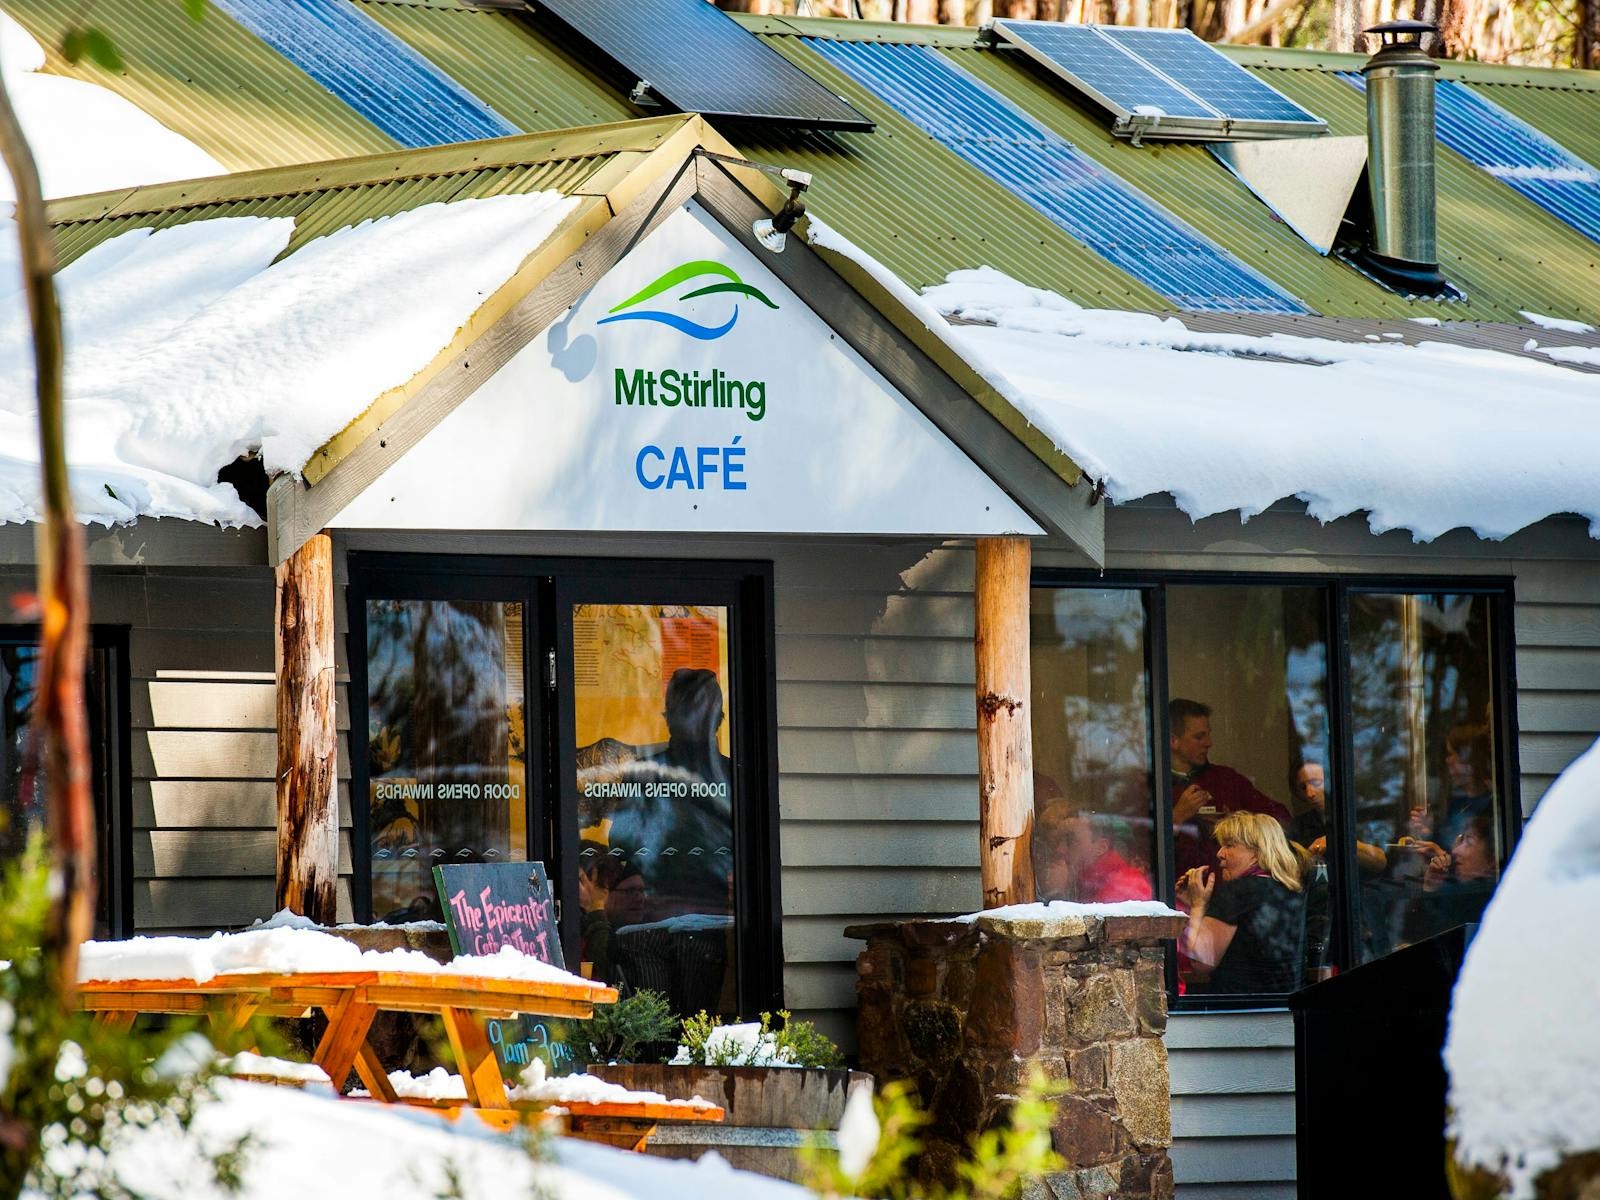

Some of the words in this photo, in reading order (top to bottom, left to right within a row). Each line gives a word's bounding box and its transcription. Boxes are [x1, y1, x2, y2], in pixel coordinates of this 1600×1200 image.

[615, 369, 765, 421] MtStirling
[636, 436, 746, 490] CAFÉ
[450, 889, 484, 931] The
[480, 886, 550, 934] Epicenter
[511, 928, 538, 957] The
